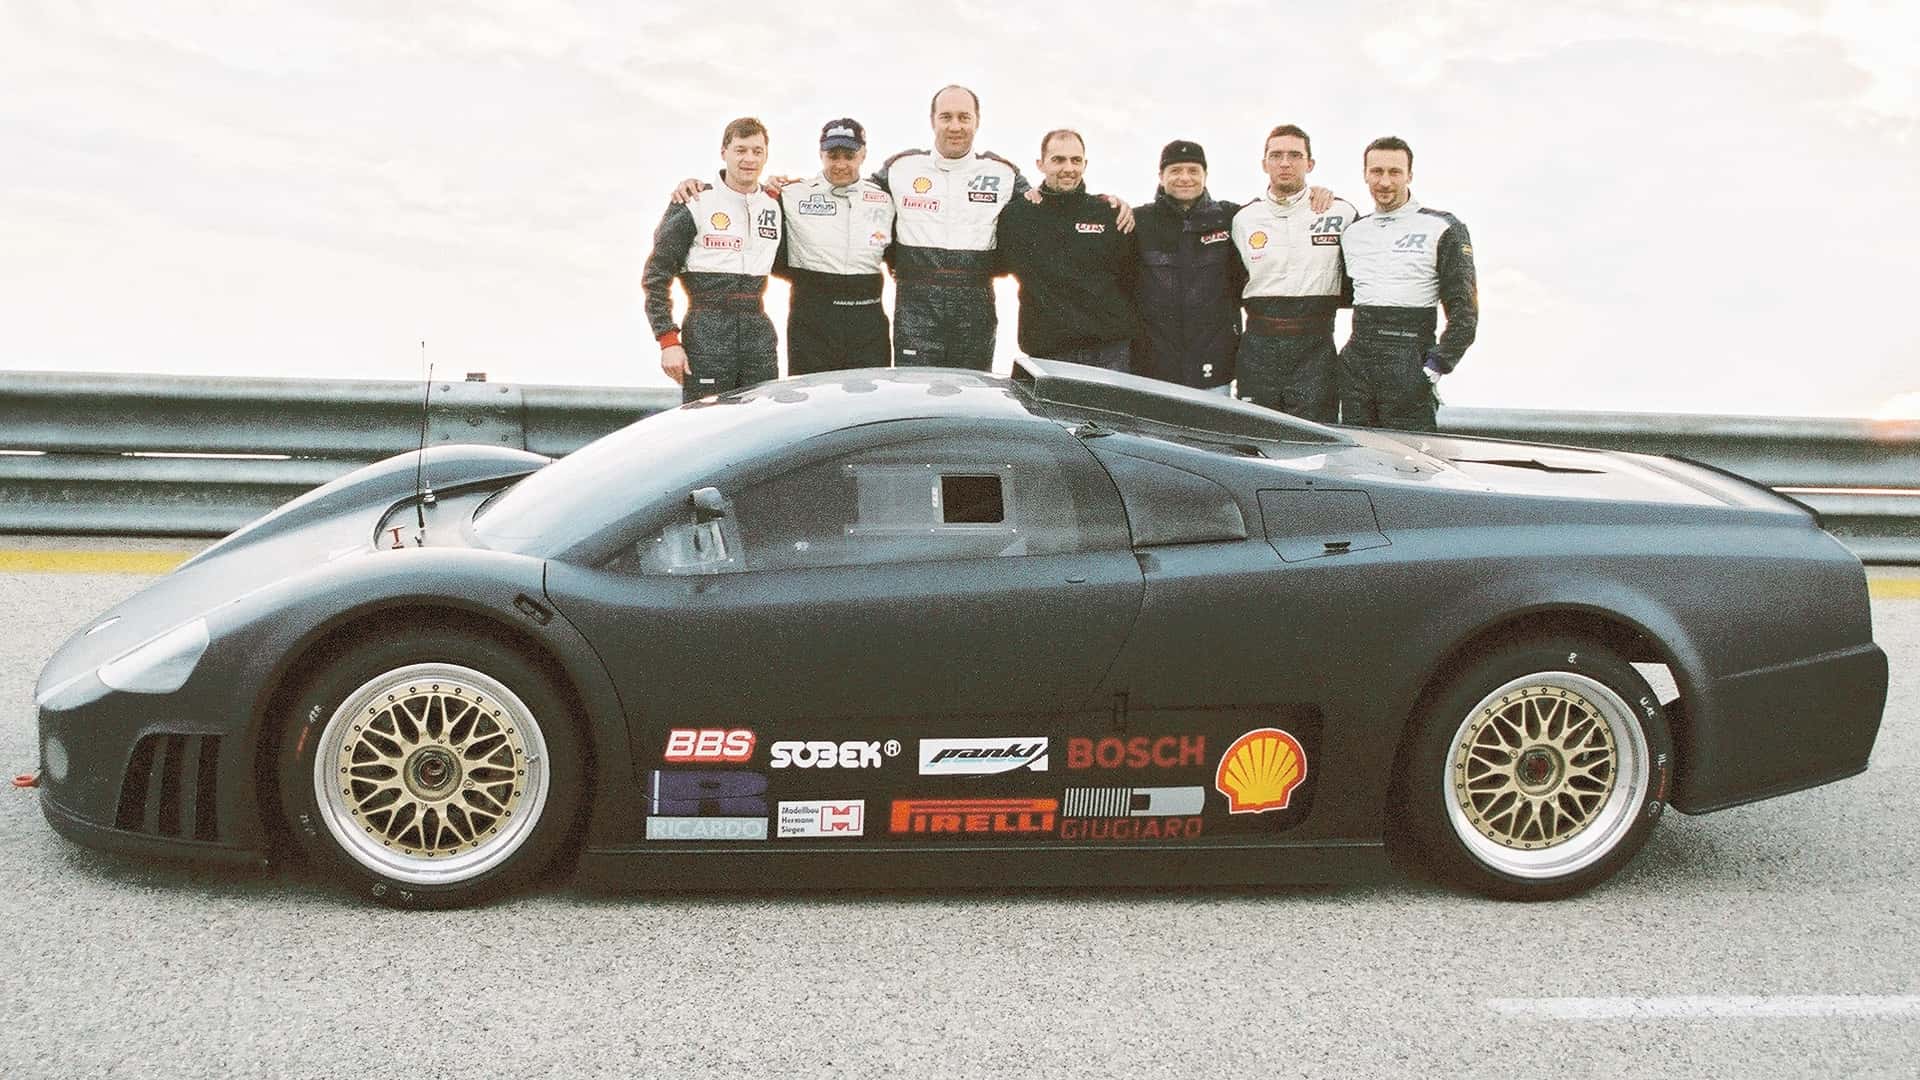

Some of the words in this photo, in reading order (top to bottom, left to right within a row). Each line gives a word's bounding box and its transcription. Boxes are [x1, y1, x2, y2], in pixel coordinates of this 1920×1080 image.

[664, 729, 755, 762] BBS
[1067, 735, 1206, 769] BOSCH
[652, 821, 763, 837] RICARDO
[891, 799, 1057, 833] PIRELLI
[1060, 818, 1204, 839] GIUGIARO
